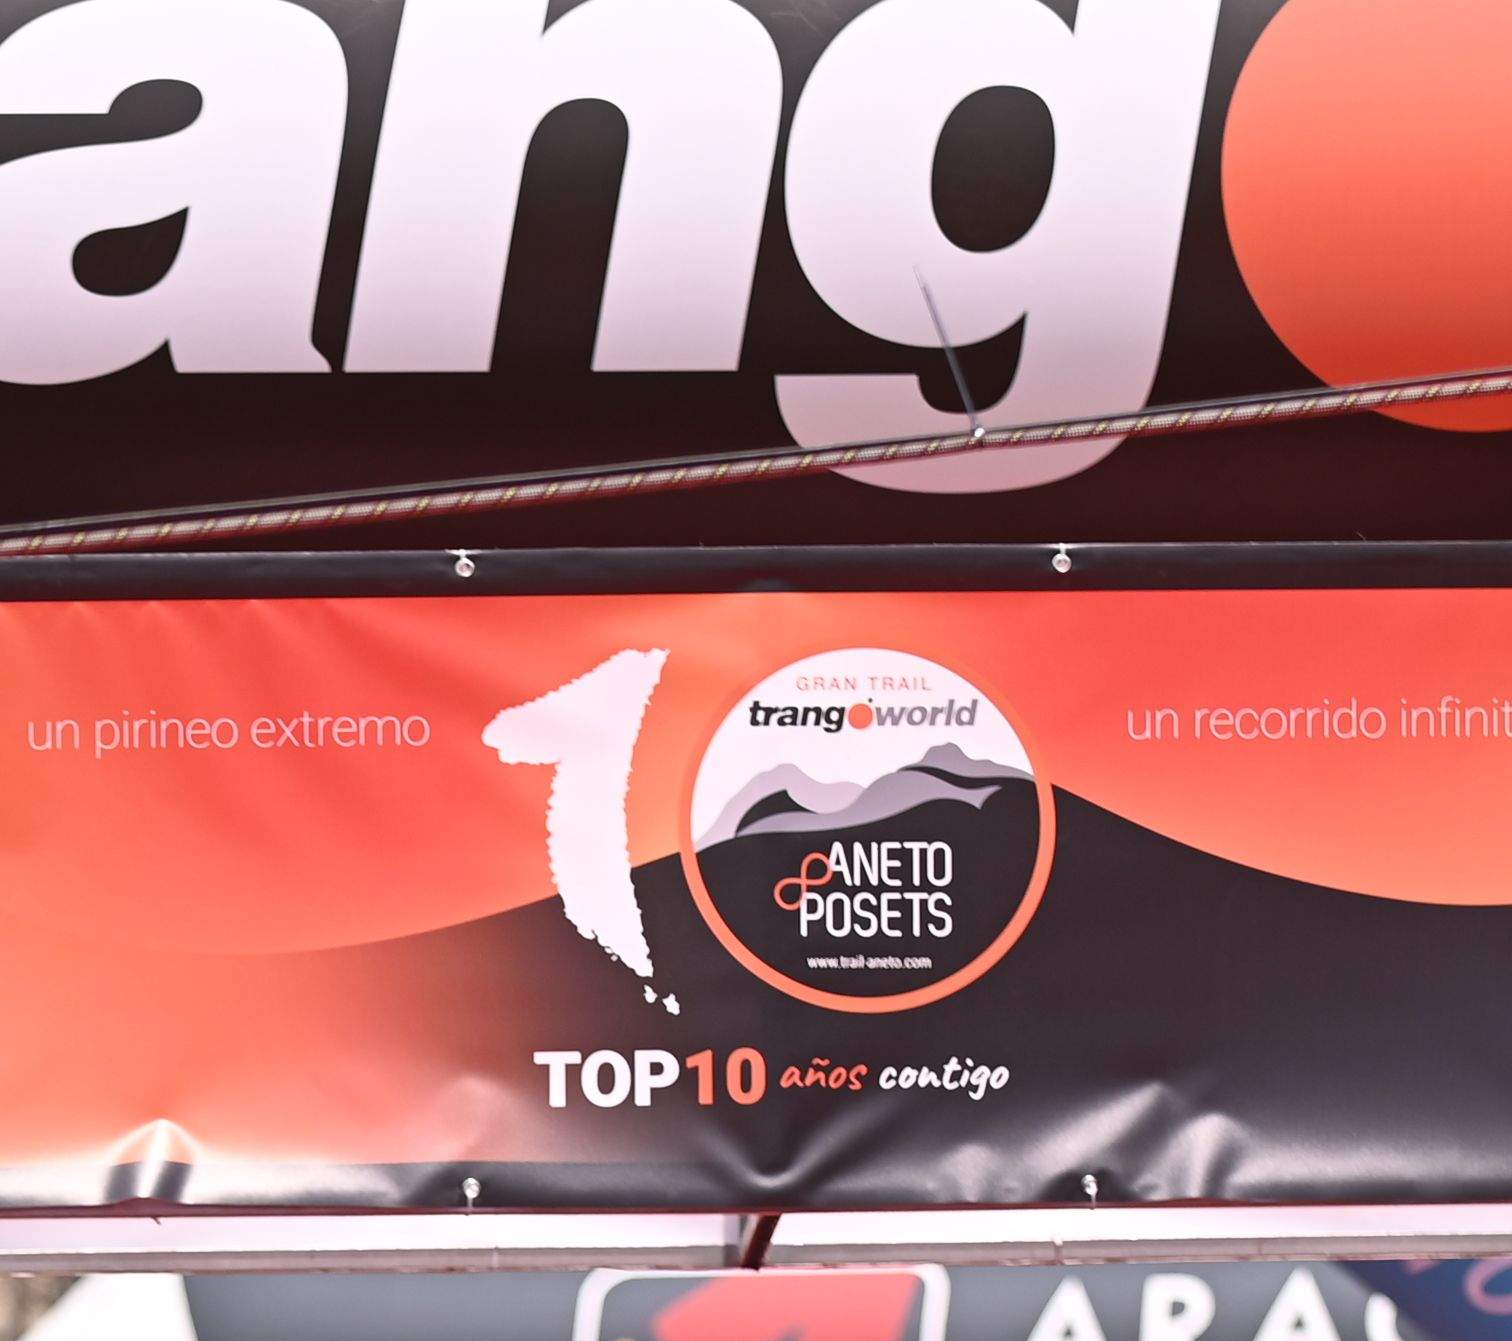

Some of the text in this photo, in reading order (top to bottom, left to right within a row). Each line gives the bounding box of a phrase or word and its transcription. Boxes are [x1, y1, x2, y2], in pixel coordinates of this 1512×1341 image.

[796, 675, 933, 692] GRAN TRAIL
[28, 708, 431, 760] un pirineo extremo
[749, 698, 978, 733] trangoworld
[1126, 706, 1180, 741] un
[1195, 696, 1386, 741] recorrido
[828, 841, 953, 887] ANETO
[799, 892, 954, 938] POSETS
[779, 1057, 868, 1092] años
[878, 1055, 1011, 1100] contigo
